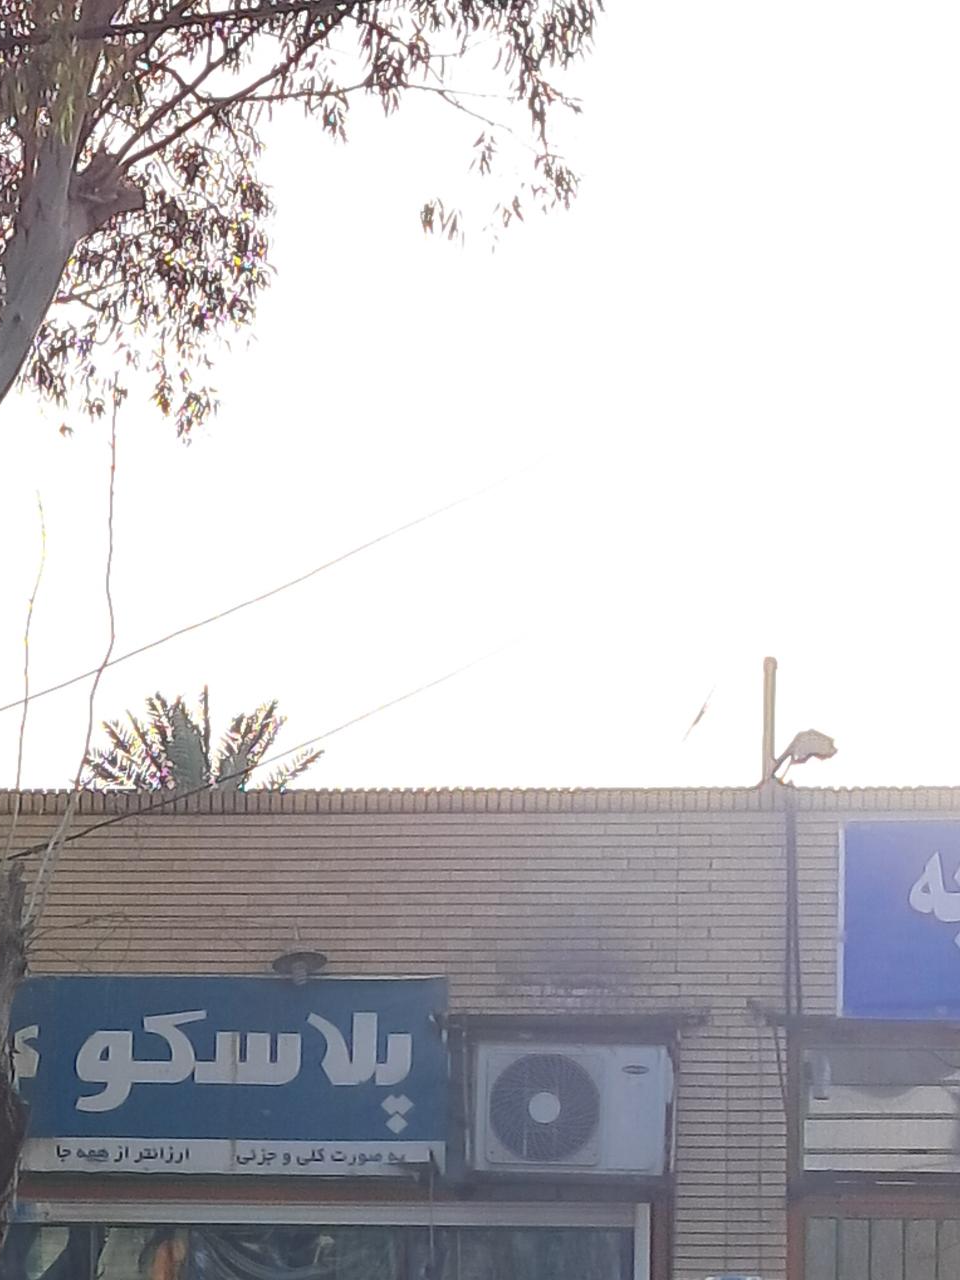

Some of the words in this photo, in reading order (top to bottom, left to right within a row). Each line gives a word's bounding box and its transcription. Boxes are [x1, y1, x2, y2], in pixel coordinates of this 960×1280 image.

[76, 1009, 414, 1134] پلاسکو
[55, 1144, 72, 1162] جا
[76, 1146, 110, 1162] همه
[113, 1145, 130, 1163] از
[133, 1145, 190, 1164] ارزانتر
[235, 1148, 278, 1166] جزئی
[282, 1152, 292, 1166] و
[296, 1147, 325, 1166] کلی
[330, 1150, 383, 1166] صورت
